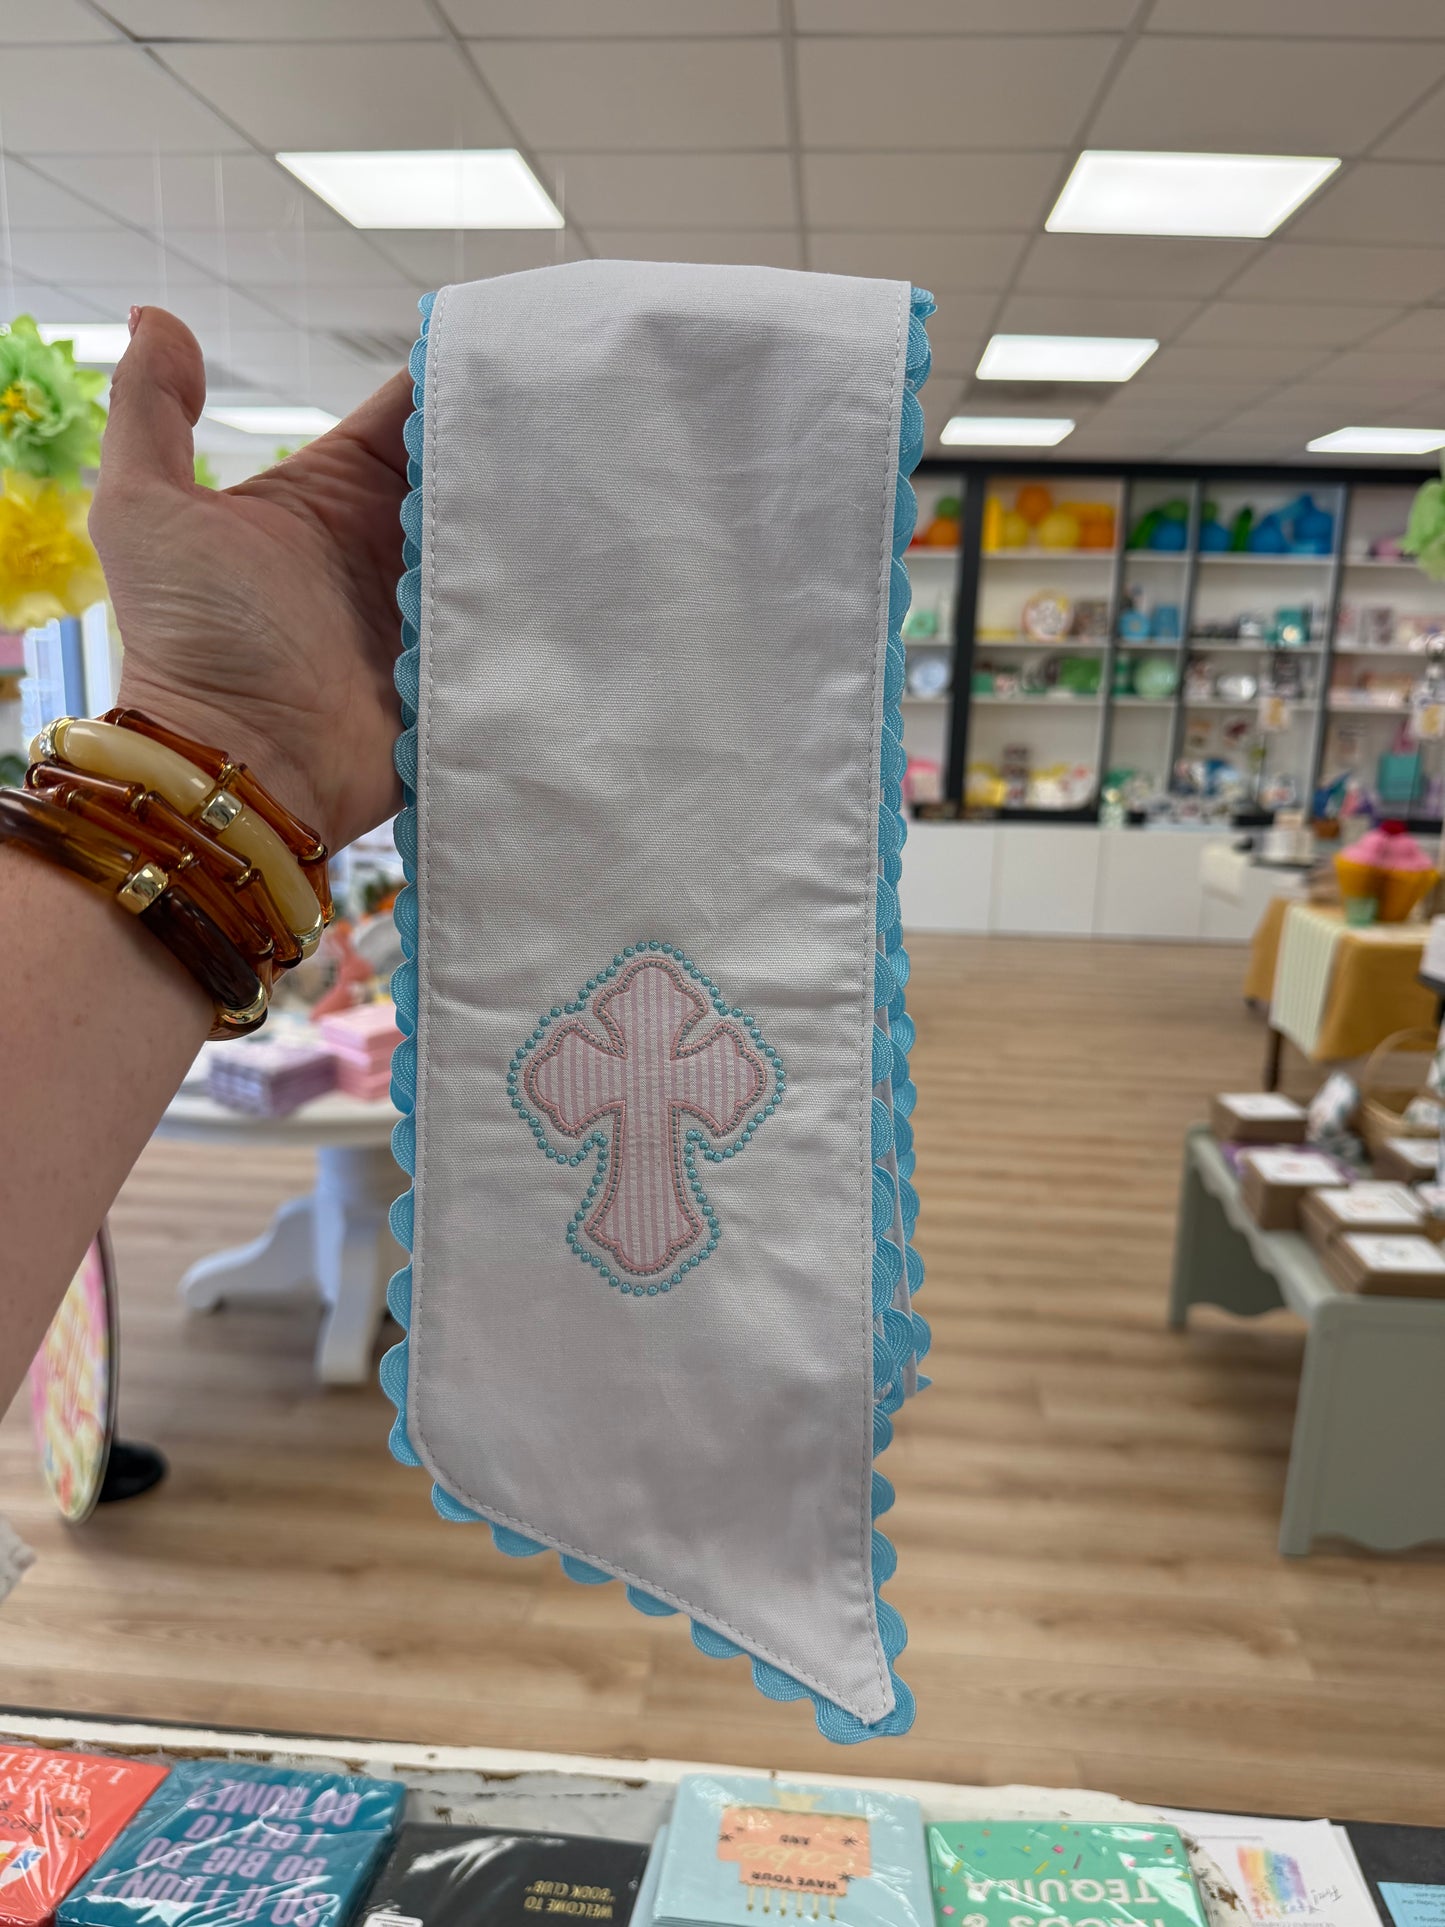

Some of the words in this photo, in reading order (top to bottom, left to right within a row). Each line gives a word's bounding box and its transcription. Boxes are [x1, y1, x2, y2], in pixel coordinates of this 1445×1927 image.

[185, 1777, 312, 1820] HOME?
[309, 1790, 363, 1827] GO
[183, 1814, 234, 1843] TO
[233, 1821, 303, 1850] GET
[303, 1827, 325, 1854] I
[136, 1836, 194, 1870] DO
[201, 1846, 272, 1879] BIG
[271, 1854, 329, 1884] GO
[751, 1870, 795, 1886] YOUR
[798, 1876, 838, 1890] HAVE
[86, 1867, 207, 1907] DONT
[203, 1879, 231, 1916] I
[226, 1883, 273, 1921] IF
[963, 1877, 1160, 1904] TEQUILA
[270, 1888, 328, 1927] SO
[523, 1895, 544, 1911] TO
[545, 1898, 613, 1919] WELCOME
